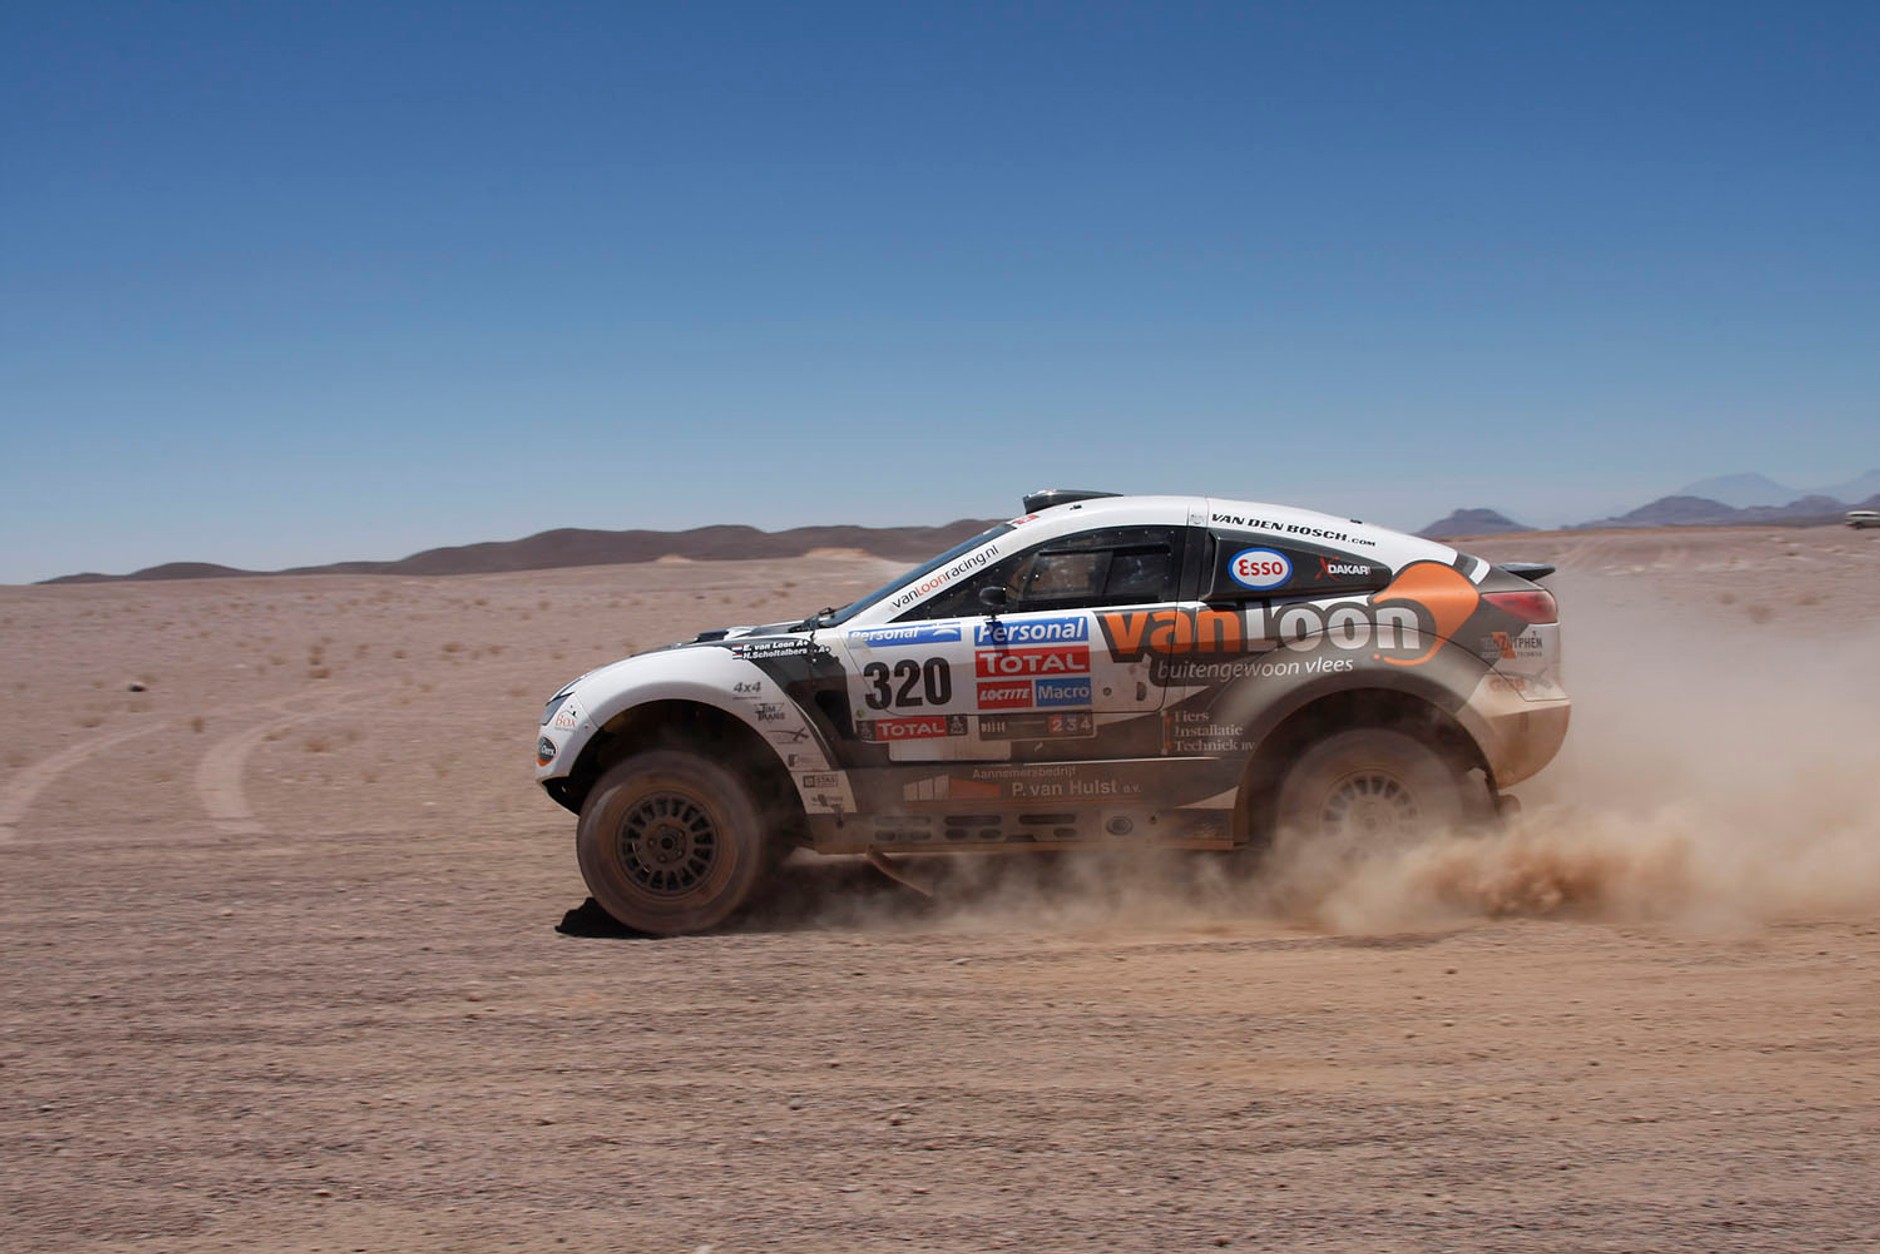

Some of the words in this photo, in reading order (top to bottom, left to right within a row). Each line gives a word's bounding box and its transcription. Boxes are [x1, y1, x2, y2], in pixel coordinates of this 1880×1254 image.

[1211, 513, 1245, 525] VAN
[1248, 519, 1284, 531] DEN
[978, 617, 1084, 643] Personal
[1157, 660, 1300, 681] buitengewoon
[1304, 655, 1354, 673] vlees
[863, 656, 952, 710] 320
[980, 687, 1030, 701] LOCTITE
[1037, 685, 1090, 700] Macro
[1030, 783, 1063, 796] van
[1069, 780, 1117, 795] Hulst
